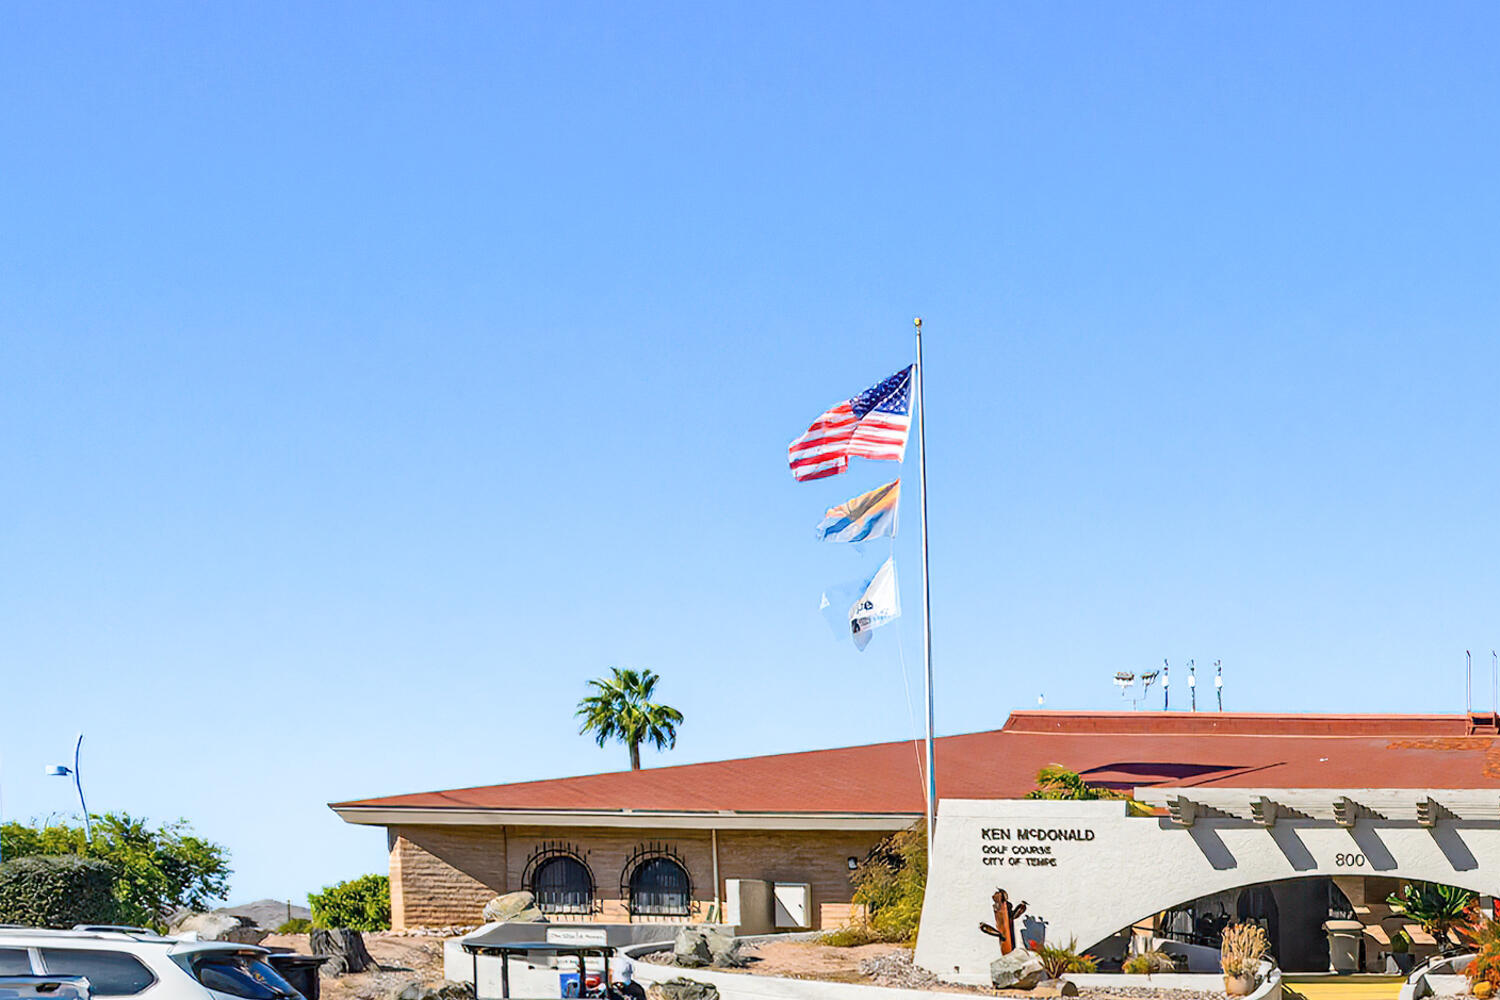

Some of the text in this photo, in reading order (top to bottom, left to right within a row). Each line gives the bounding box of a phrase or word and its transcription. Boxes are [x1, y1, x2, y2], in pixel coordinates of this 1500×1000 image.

[981, 828, 1095, 841] KEN McDONALD
[982, 845, 1008, 854] GOLF
[982, 857, 1005, 866] CITY
[1335, 853, 1365, 867] 800
